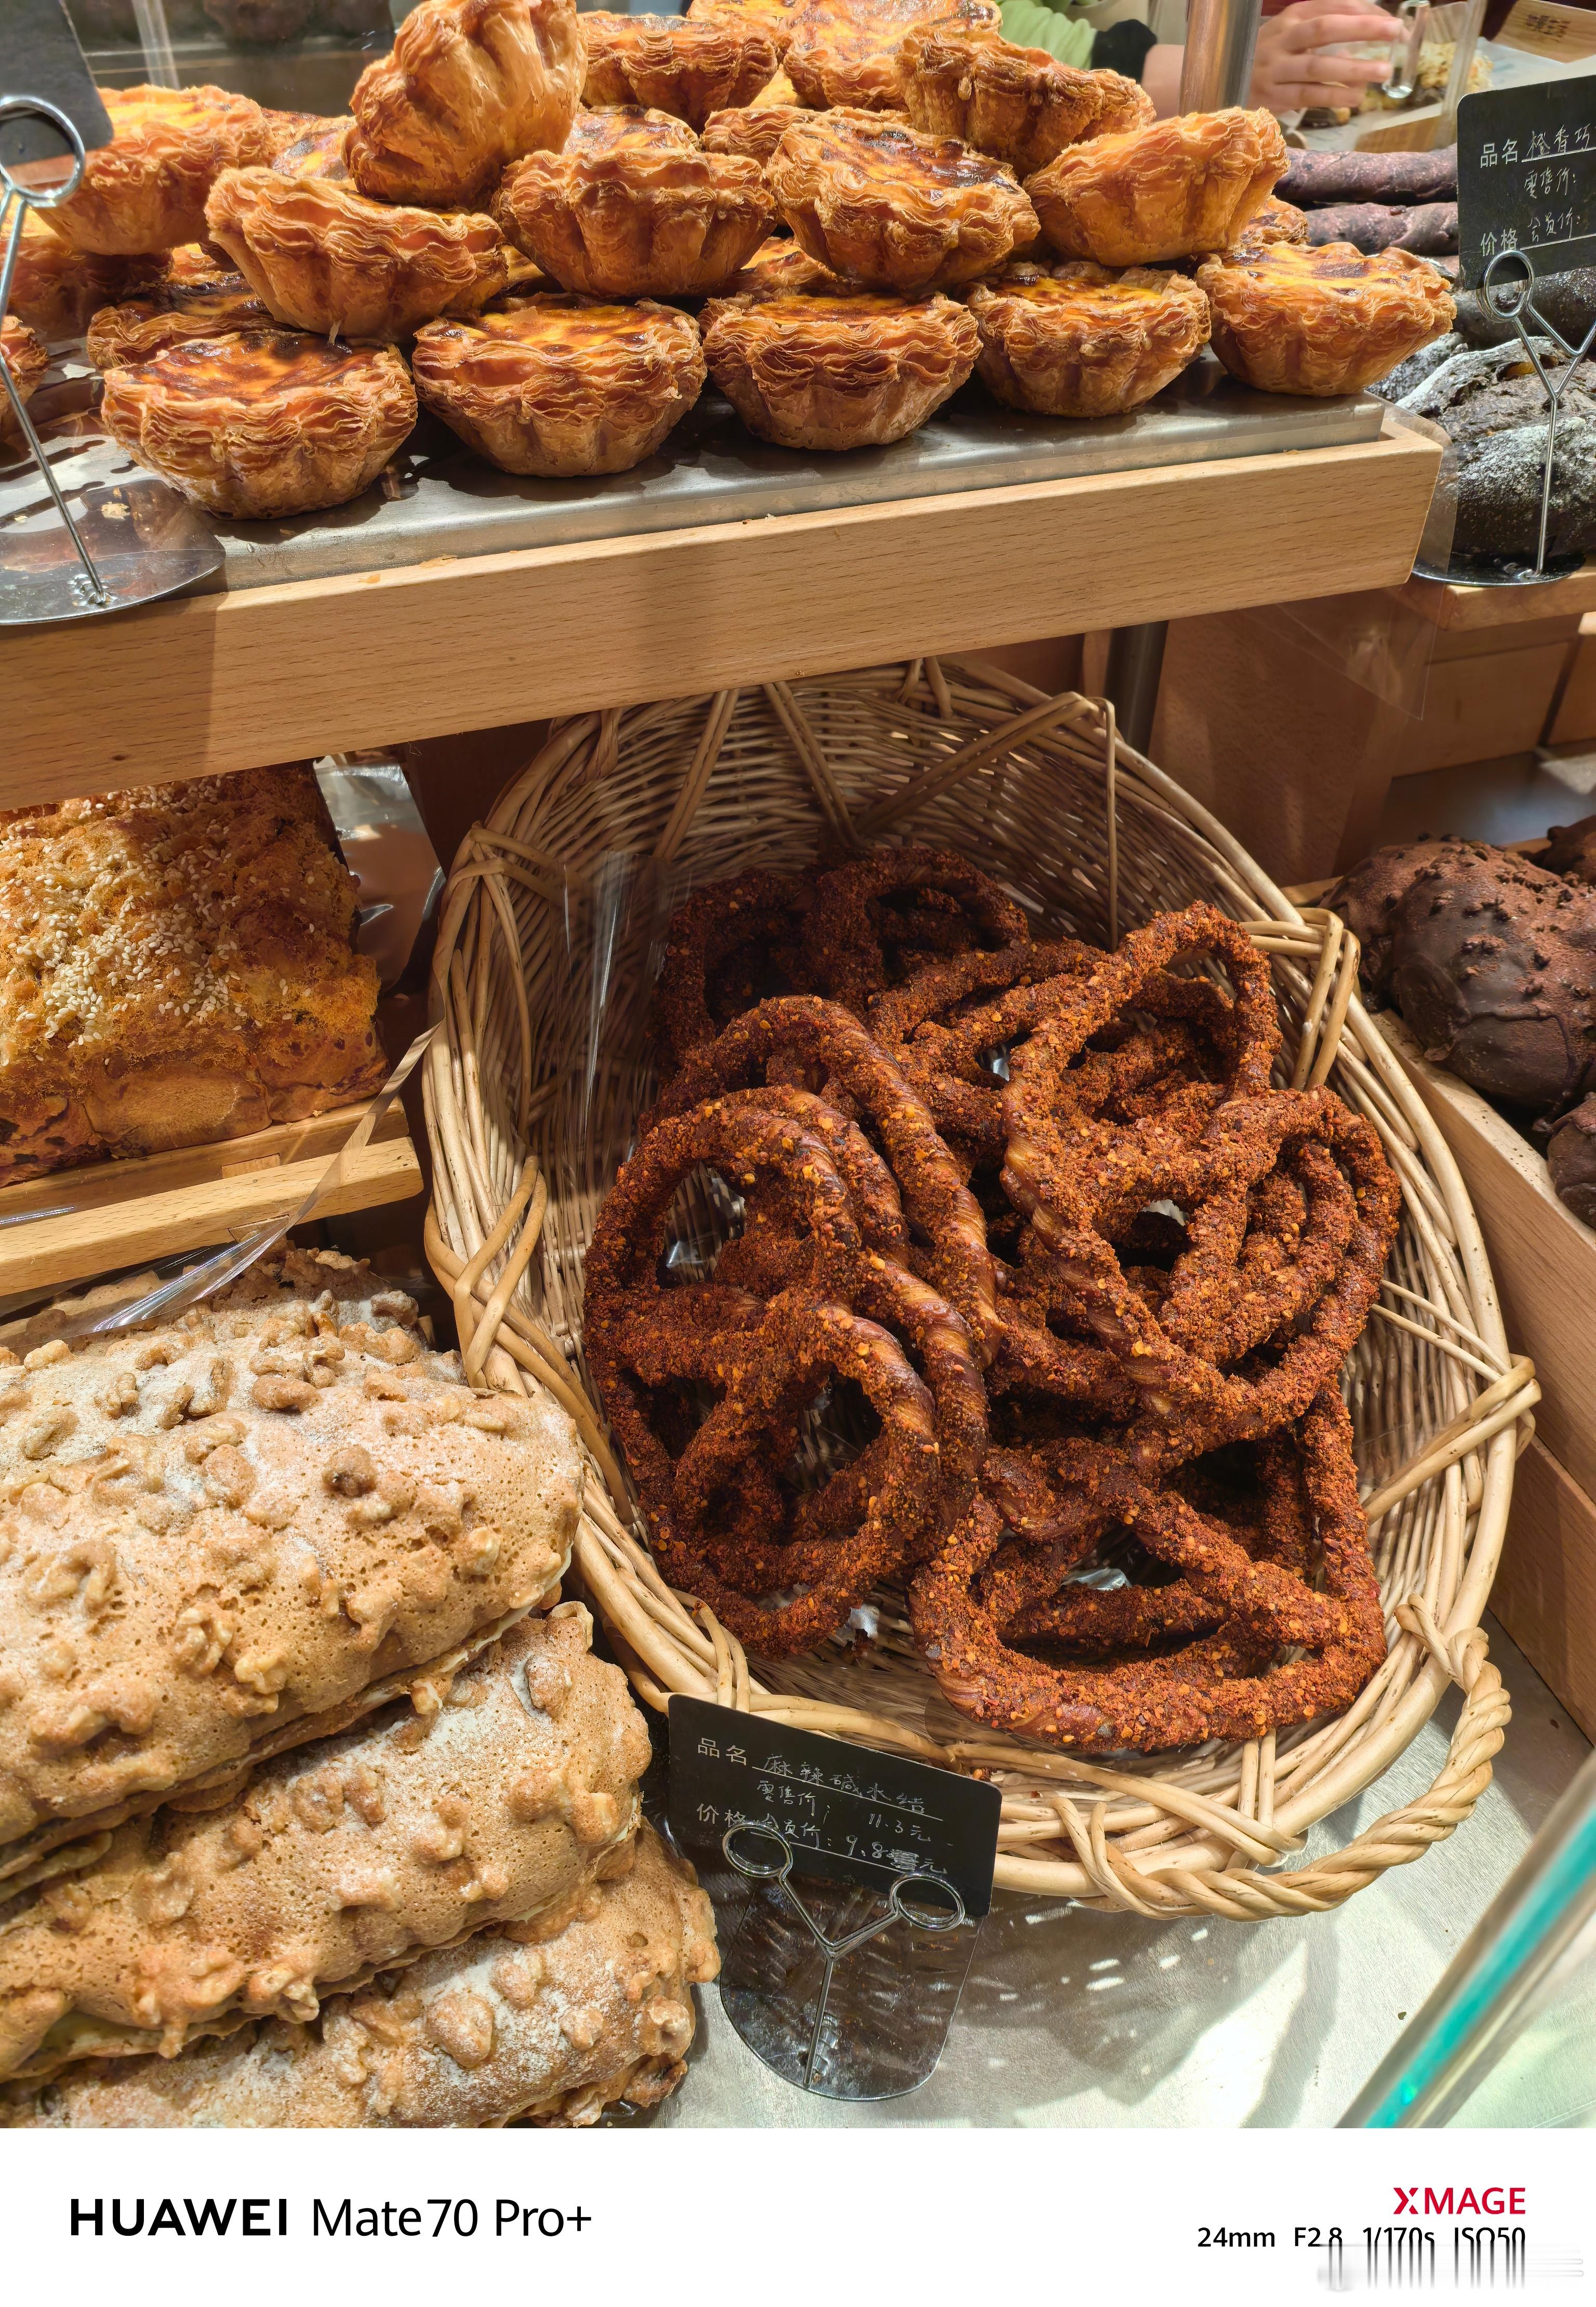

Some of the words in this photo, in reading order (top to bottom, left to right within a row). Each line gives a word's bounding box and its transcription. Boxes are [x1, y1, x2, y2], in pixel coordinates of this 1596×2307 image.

[1480, 138, 1518, 168] 品名
[1526, 124, 1596, 160] 橙香巧
[1480, 228, 1518, 257] 价格
[698, 1737, 747, 1766] 品名
[763, 1754, 926, 1814] 麻辣碱水结
[697, 1803, 746, 1827] 价格
